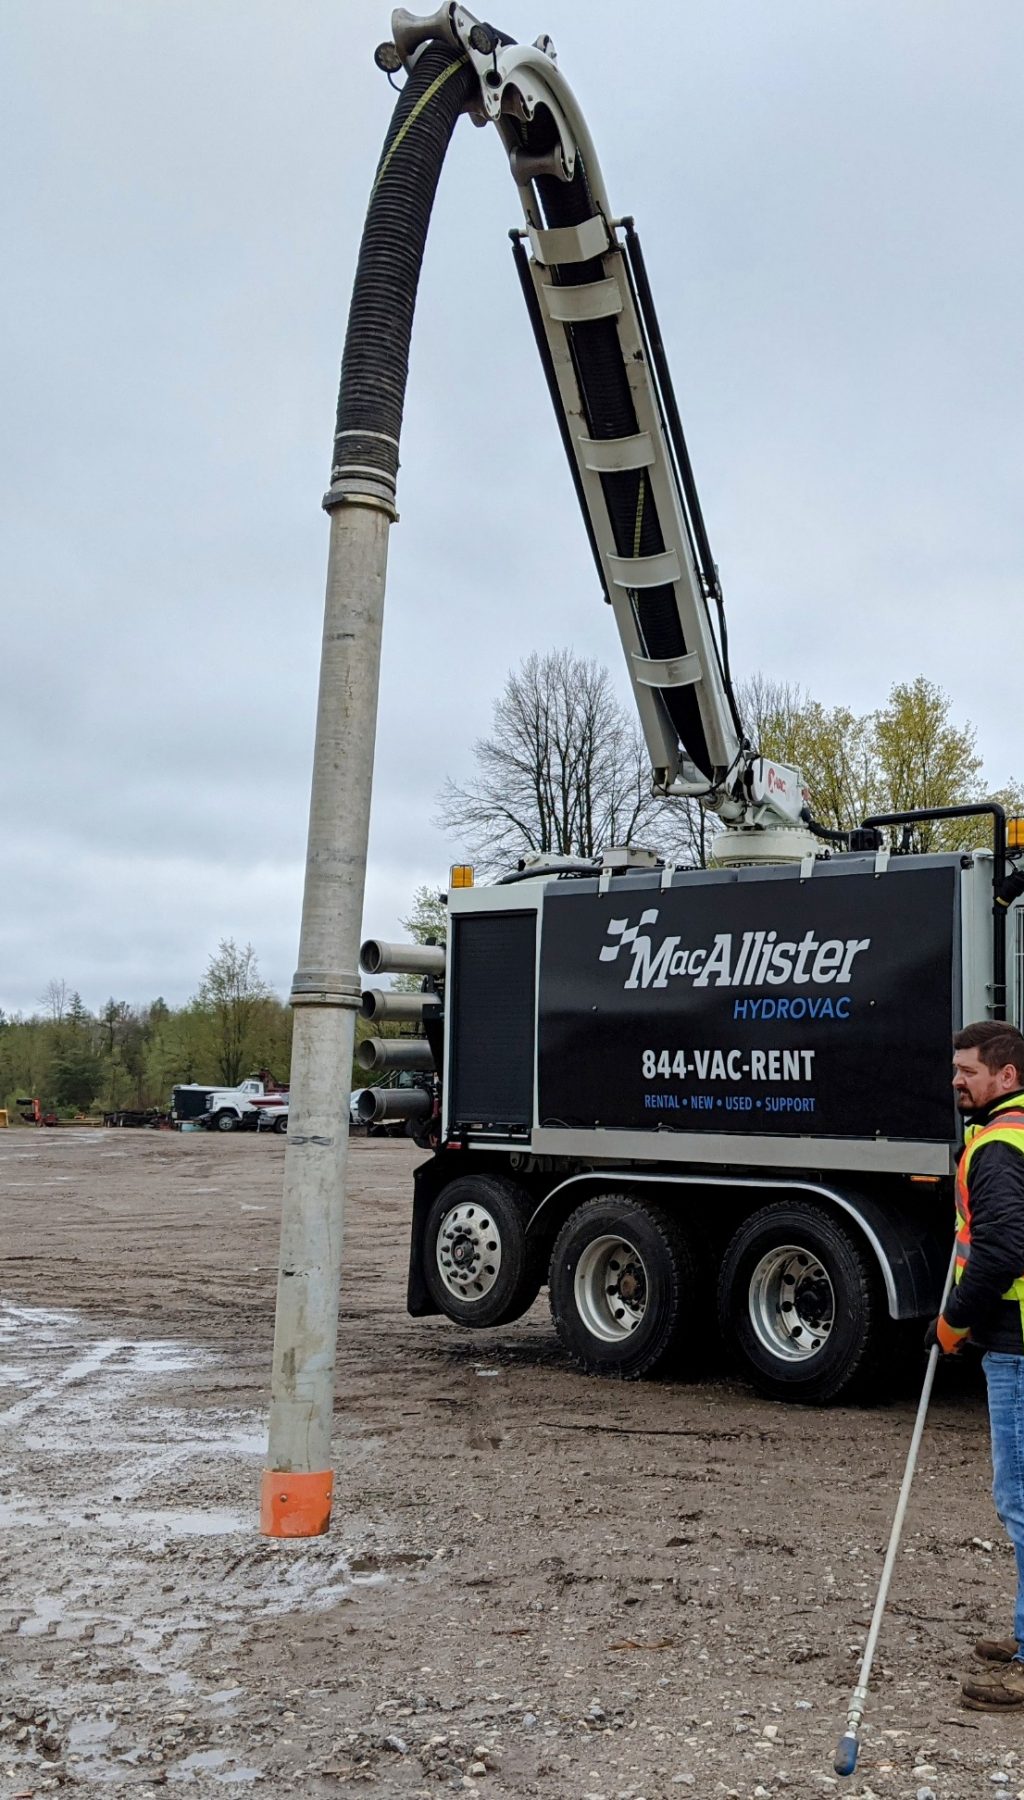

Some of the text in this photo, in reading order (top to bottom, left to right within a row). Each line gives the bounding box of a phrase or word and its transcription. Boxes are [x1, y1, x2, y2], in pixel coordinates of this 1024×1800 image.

[624, 930, 870, 989] MacAllister
[733, 997, 851, 1020] HYDROVAC
[642, 1049, 815, 1081] 844-VAC-RENT
[644, 1094, 815, 1113] RENTAL NEW USED SUPPORT
